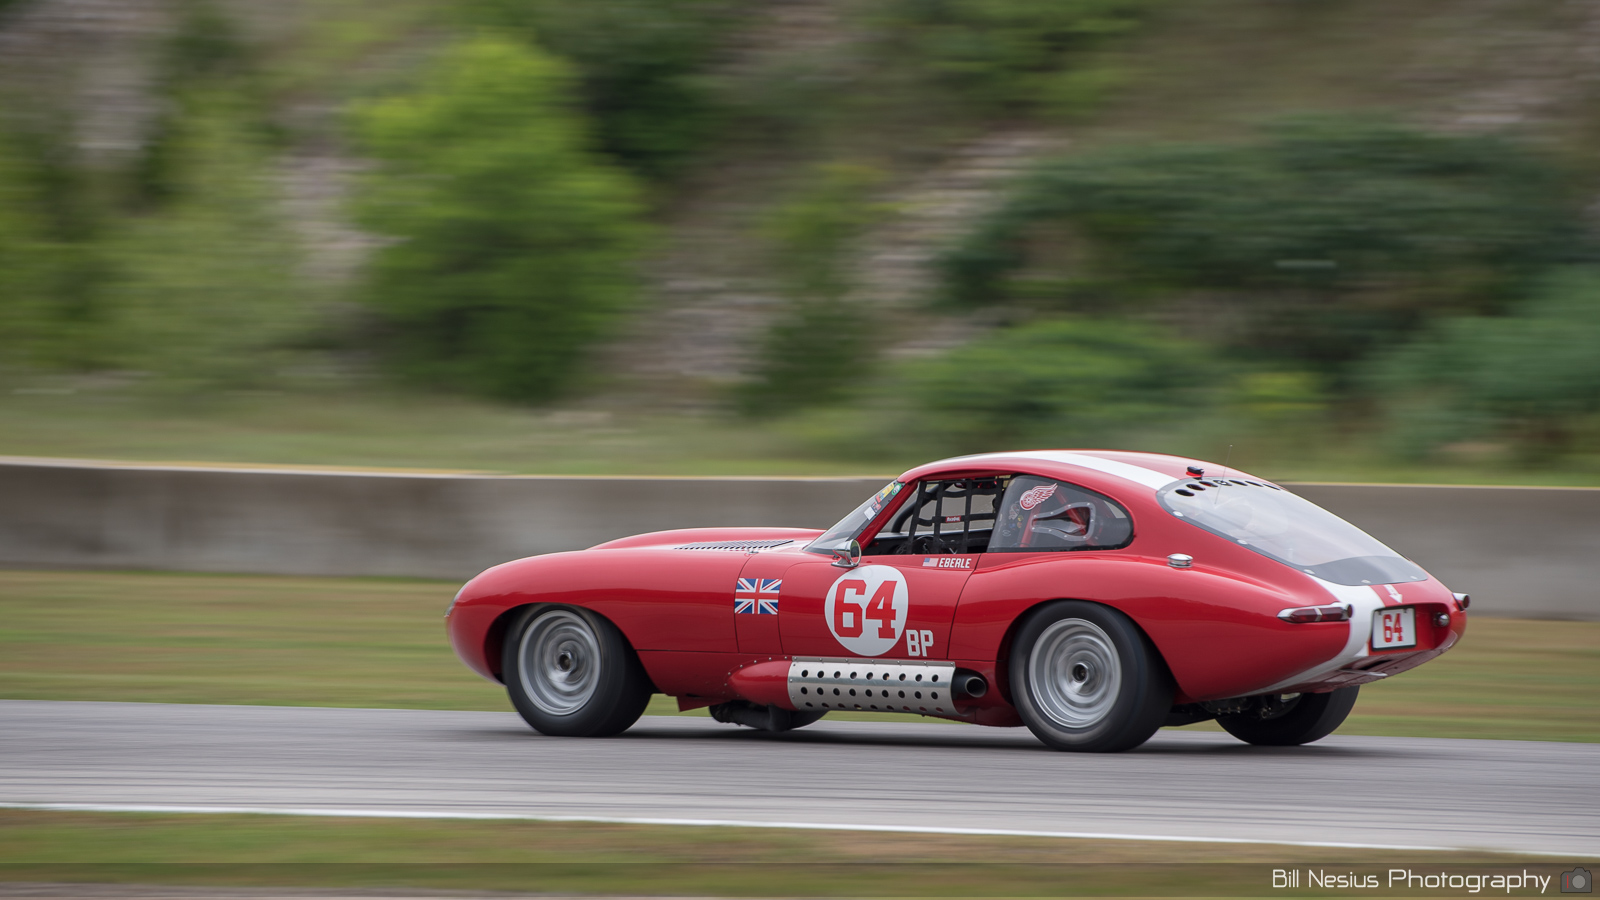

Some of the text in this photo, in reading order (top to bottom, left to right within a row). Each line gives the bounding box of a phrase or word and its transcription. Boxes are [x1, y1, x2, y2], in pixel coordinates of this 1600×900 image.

[938, 557, 972, 569] EBERLE
[833, 579, 898, 639] 64
[1382, 613, 1404, 643] 64
[905, 629, 934, 657] BP
